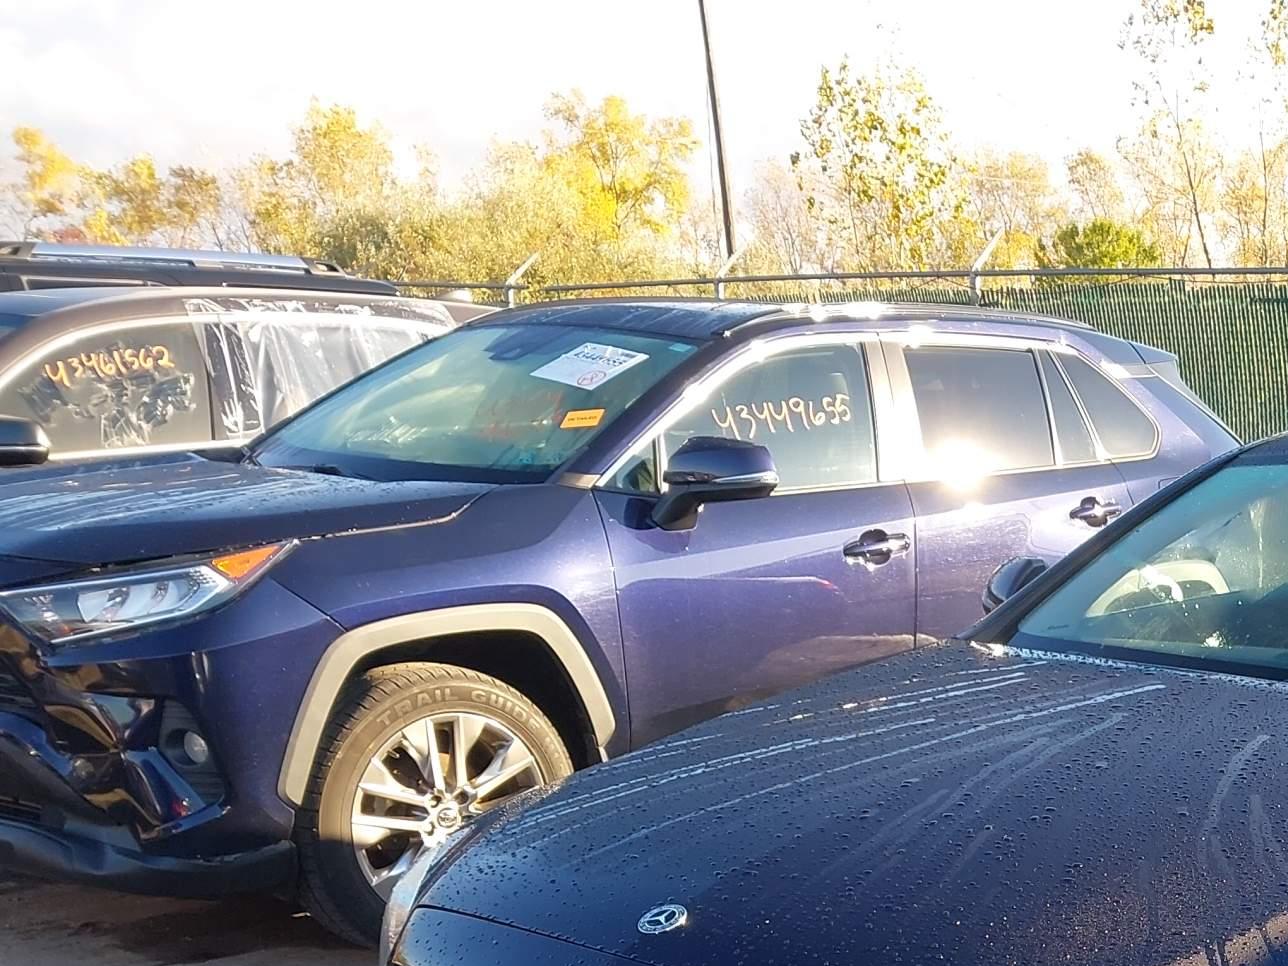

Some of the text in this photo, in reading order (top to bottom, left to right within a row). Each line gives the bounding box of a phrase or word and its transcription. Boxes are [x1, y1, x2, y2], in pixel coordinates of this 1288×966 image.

[44, 346, 175, 389] 43461562
[711, 393, 851, 440] 43449655
[376, 687, 541, 732] TRAIL GUIDE
